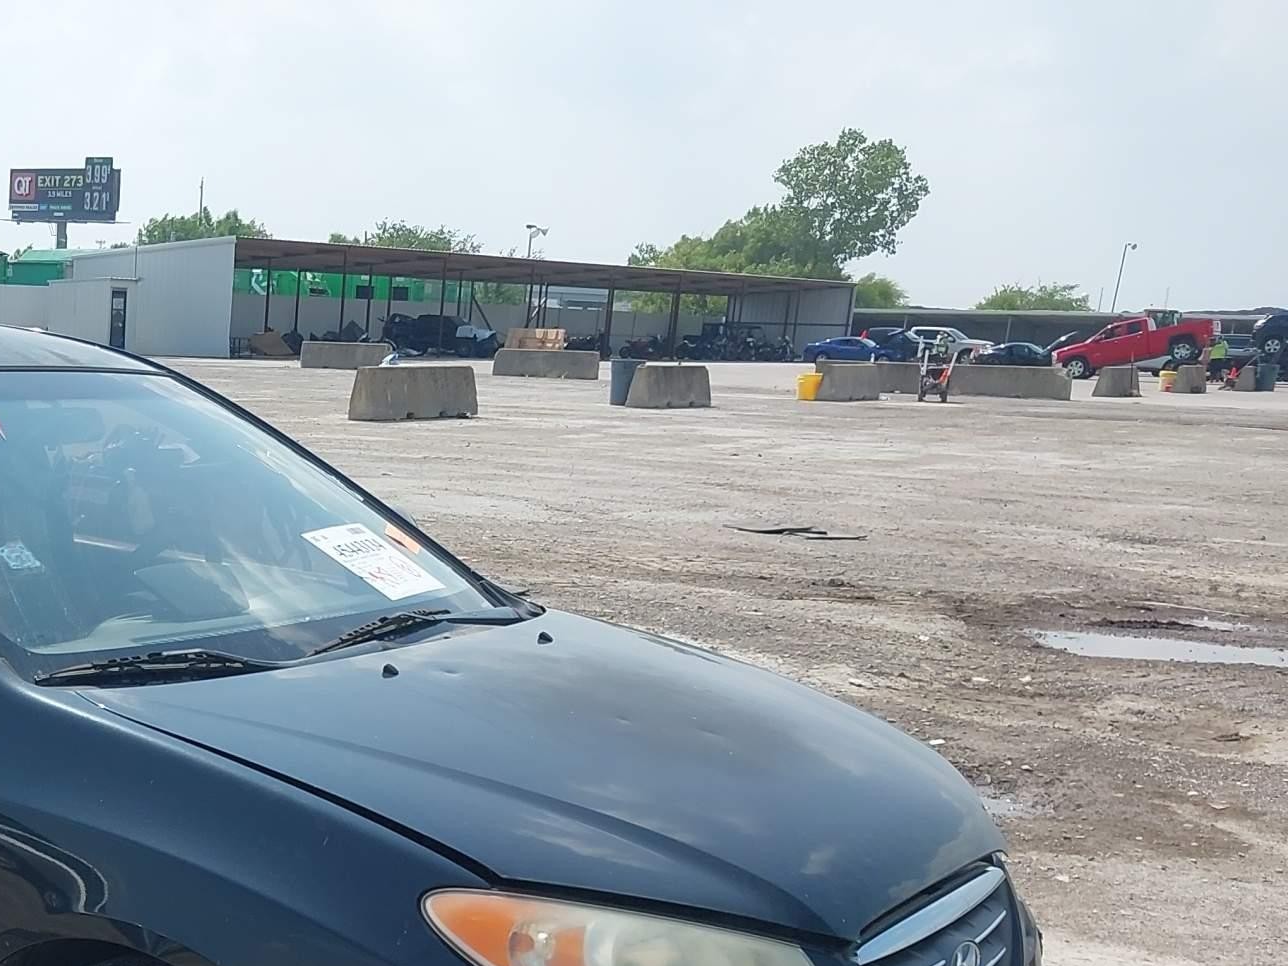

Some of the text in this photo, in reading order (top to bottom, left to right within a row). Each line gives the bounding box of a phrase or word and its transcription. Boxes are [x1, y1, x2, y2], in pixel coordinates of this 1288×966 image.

[14, 176, 32, 196] QT
[37, 175, 83, 187] EXIT 273
[56, 190, 72, 198] MILES
